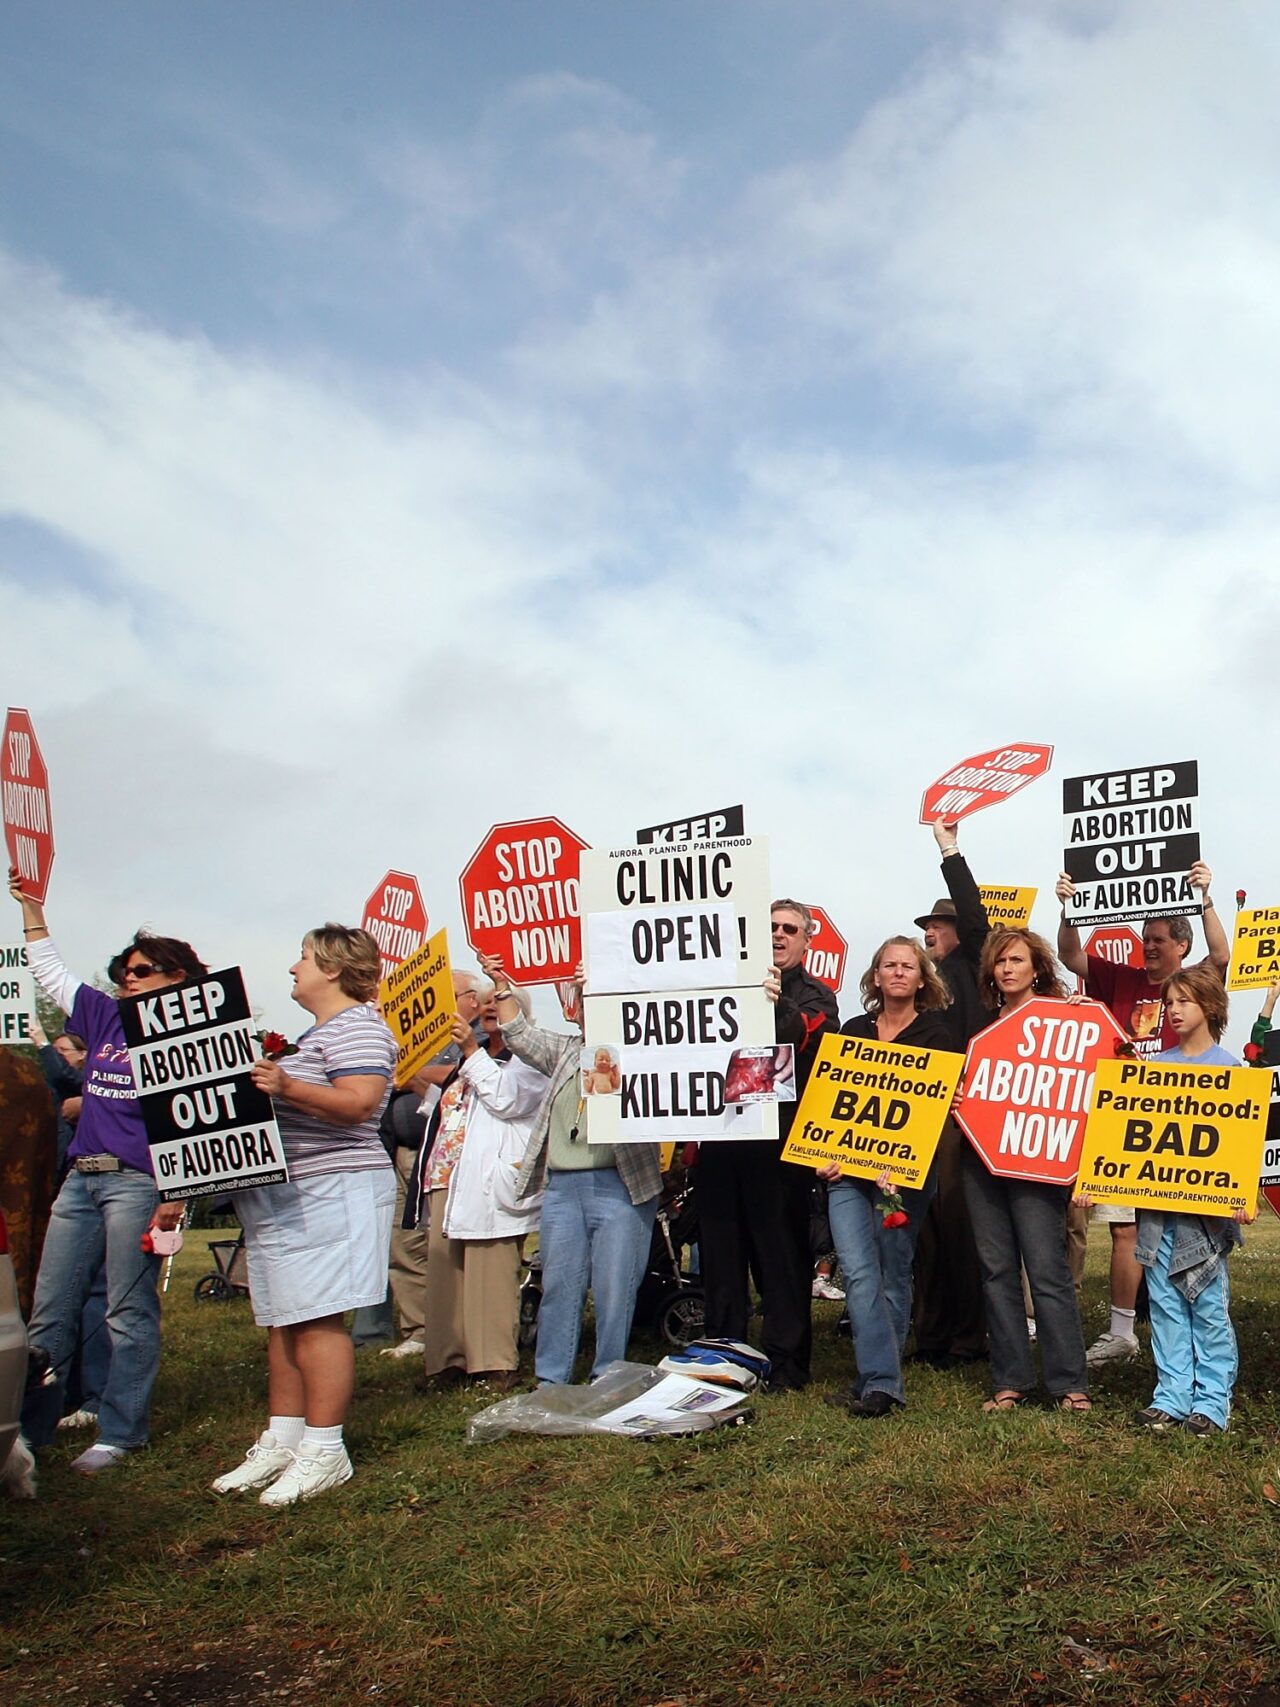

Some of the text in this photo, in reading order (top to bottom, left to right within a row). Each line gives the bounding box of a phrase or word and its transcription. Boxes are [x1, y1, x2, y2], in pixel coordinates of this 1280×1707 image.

[10, 730, 30, 778] STOP
[984, 750, 1041, 770] STOP
[938, 767, 1034, 793] ABORTION
[1083, 769, 1176, 806] KEEP
[3, 780, 48, 834] ABORTION
[930, 789, 983, 814] NOW
[1070, 803, 1192, 843] ABORTION
[16, 833, 39, 882] NOW
[495, 836, 562, 882] STOP
[609, 838, 752, 858] AURORA PLANNED PARENTHOOD
[1095, 841, 1167, 875] OUT
[617, 852, 733, 906] CLINIC
[1073, 876, 1195, 910] OF AURORA
[381, 885, 413, 921] STOP
[473, 878, 581, 930] ABORTIO
[387, 943, 430, 992] Planned
[511, 925, 570, 969] NOW
[1095, 938, 1133, 965] STOP
[383, 956, 447, 1018] Parenthood:
[1239, 963, 1262, 975] for
[137, 981, 225, 1036] KEEP
[399, 986, 436, 1036] BAD
[622, 996, 739, 1046] BABIES
[412, 1012, 449, 1049] Aurora.
[1017, 1016, 1101, 1063] STOP
[139, 1028, 254, 1088] ABORTION
[840, 1039, 930, 1070] Planned
[621, 1071, 727, 1119] KILLED
[816, 1061, 948, 1099] Parenthood:
[966, 1058, 1096, 1114] ABORTI
[1120, 1064, 1231, 1090] Planned
[172, 1083, 237, 1129] OUT
[830, 1090, 911, 1131] BAD
[1096, 1089, 1260, 1120] Parenthood:
[159, 1129, 276, 1178] OF AURORA
[802, 1121, 917, 1161] for Aurora.
[999, 1110, 1079, 1163] NOW
[1122, 1119, 1220, 1158] BAD
[1093, 1156, 1239, 1189] for Aurora.
